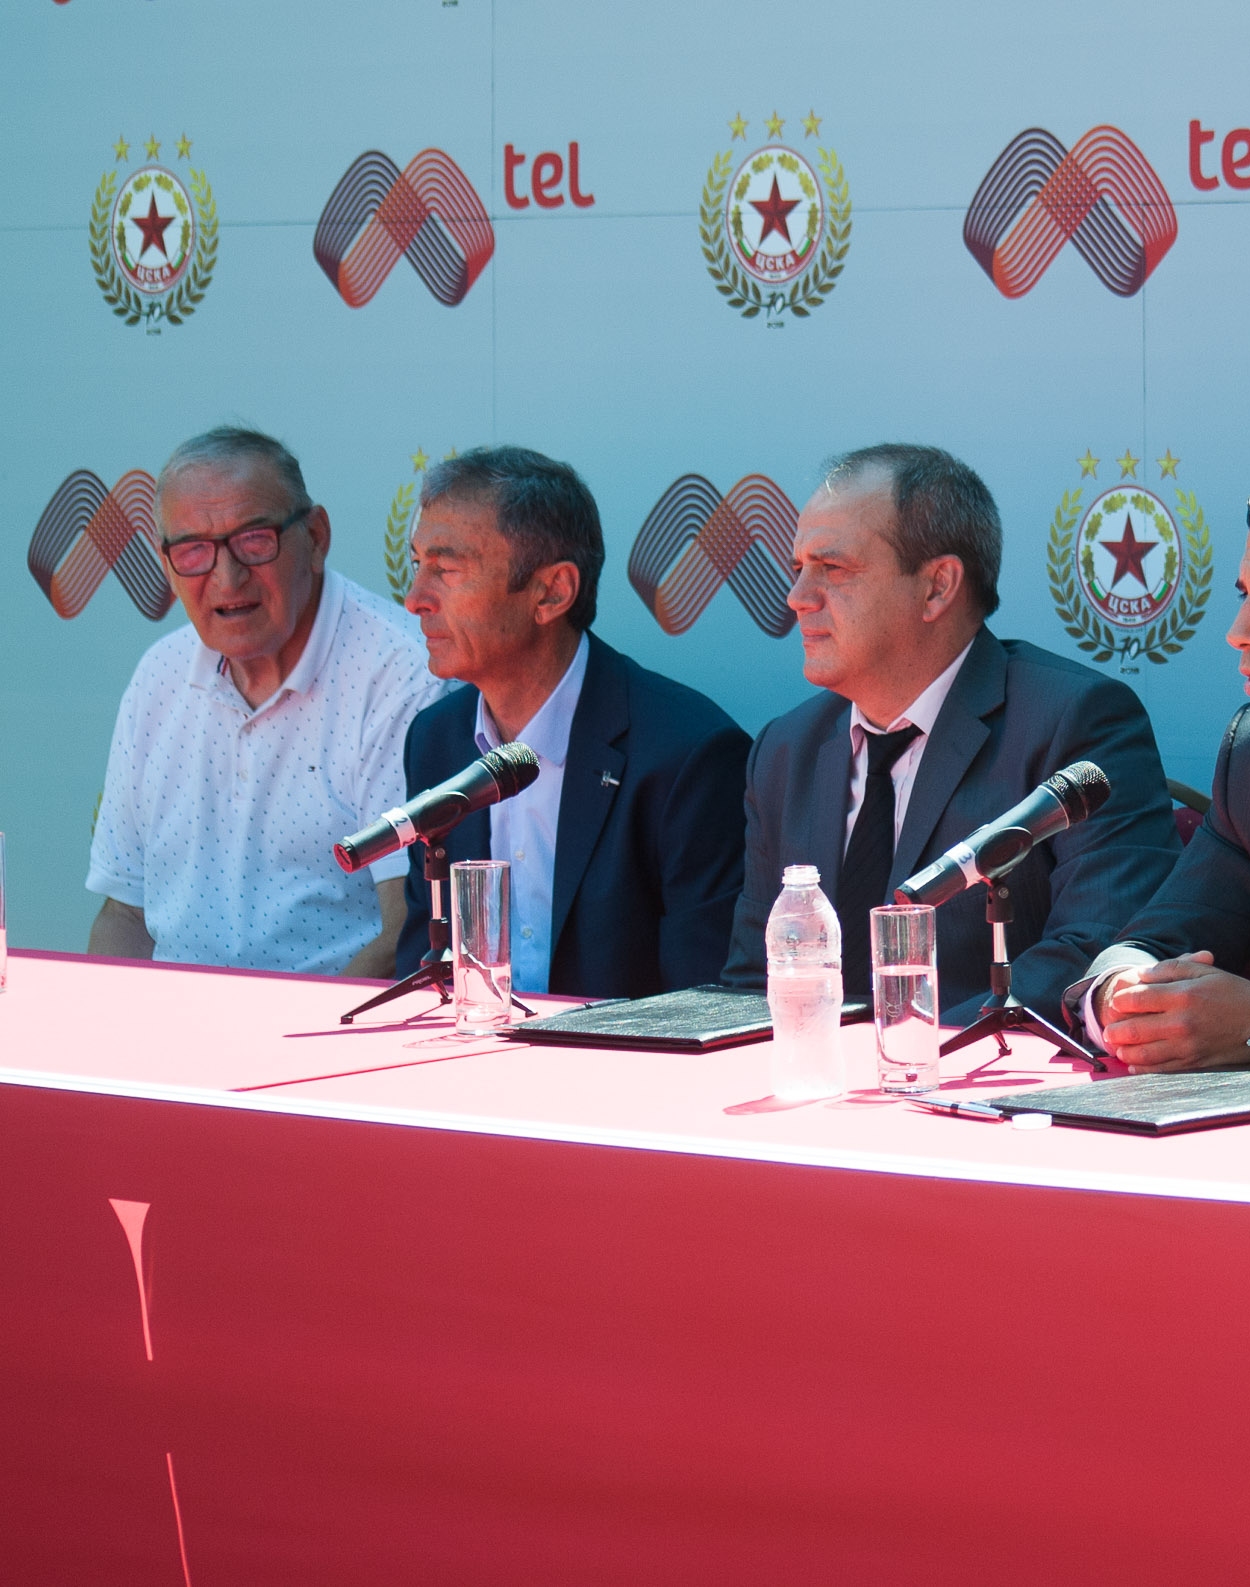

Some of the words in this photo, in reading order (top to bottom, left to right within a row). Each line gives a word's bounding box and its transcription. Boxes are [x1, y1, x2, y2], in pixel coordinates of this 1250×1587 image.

[503, 140, 596, 210] tel
[755, 252, 796, 270] ЦСКА
[1107, 595, 1152, 614] ЦСКА
